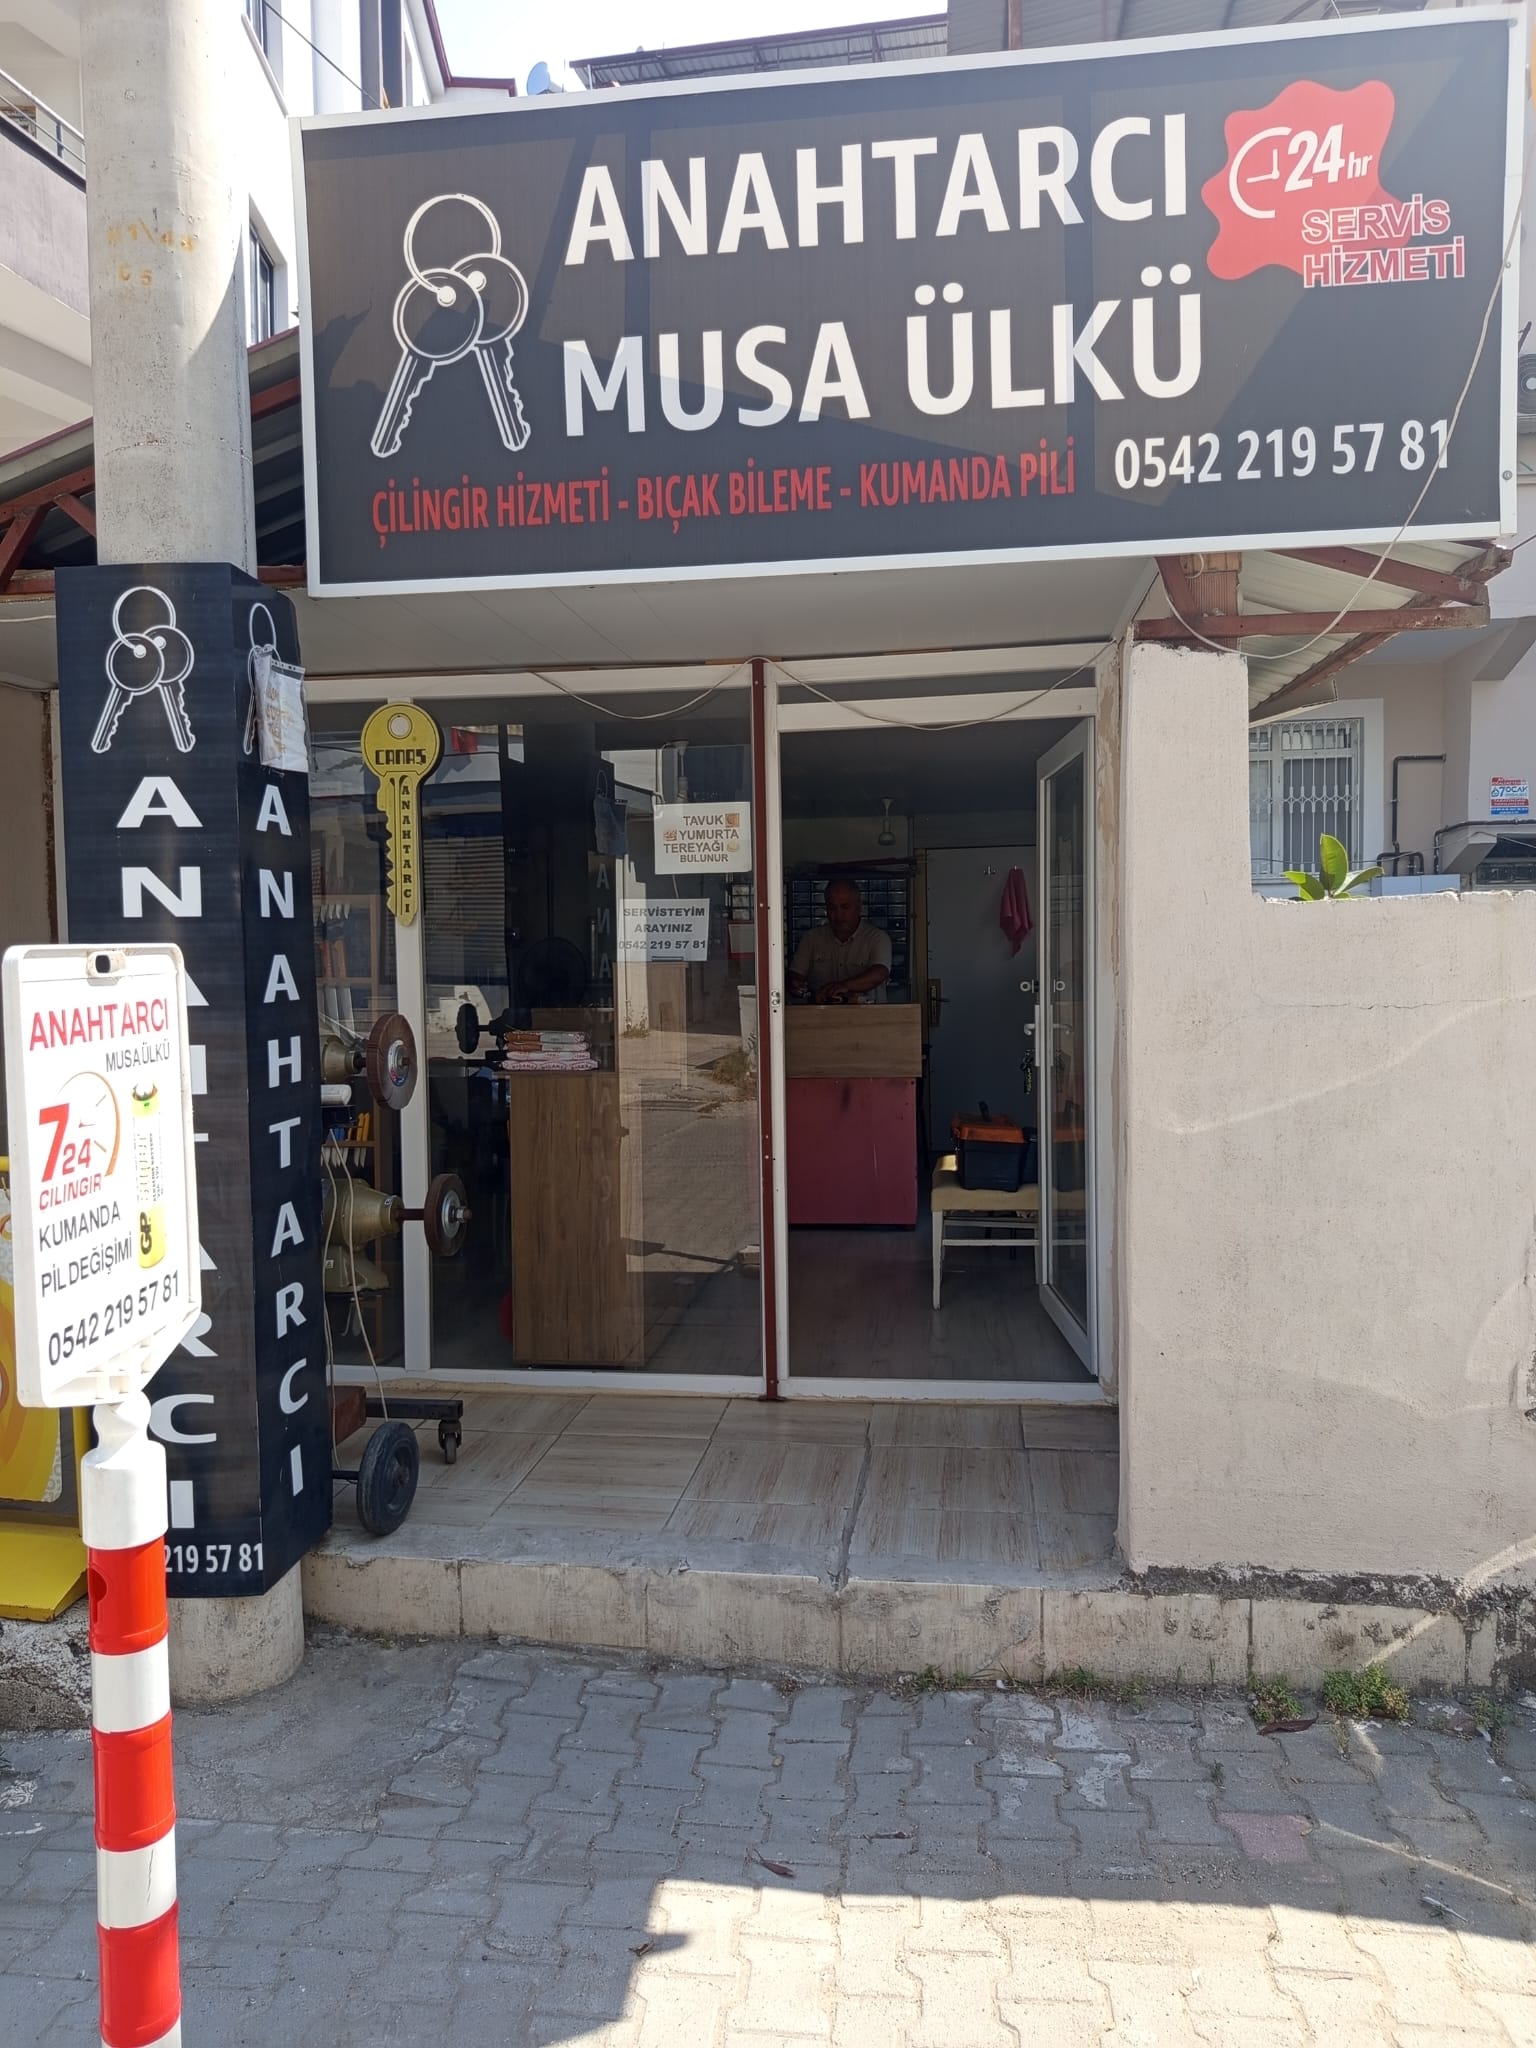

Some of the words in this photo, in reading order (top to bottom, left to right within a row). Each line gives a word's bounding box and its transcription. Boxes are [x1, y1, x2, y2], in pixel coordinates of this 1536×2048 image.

[564, 113, 1188, 267] ANAHTARCI
[1301, 193, 1450, 245] SERVİS
[1303, 235, 1466, 289] HİZMETİ
[563, 321, 871, 438] MUSA
[906, 263, 1202, 415] ÜLKÜ
[1113, 432, 1222, 490] 0542
[1237, 426, 1317, 481] 219
[1331, 422, 1385, 474] 57
[1399, 419, 1449, 472] 81
[372, 474, 489, 549] ÇİLİNGİR
[497, 466, 609, 527] HİZMETİ
[637, 473, 721, 534] BIÇAK
[728, 457, 832, 515] BİLEME
[860, 455, 1011, 508] KUMANDA
[1020, 436, 1075, 497] PİLİ
[679, 830, 739, 841] YUMURTA
[683, 815, 724, 826] TAVUK
[401, 785, 413, 914] ANAHTARCI
[663, 840, 724, 854] TEREYAĞI
[680, 853, 729, 863] BULUNUR
[623, 905, 705, 917] SERVİSTEYİM
[634, 923, 693, 933] ARAYINIZ
[618, 940, 647, 950] 0542
[650, 940, 671, 950] 219
[675, 940, 690, 950] 57
[692, 940, 706, 949] 81
[29, 998, 169, 1052] ANAHTARCI
[62, 1138, 92, 1176] 24
[256, 784, 310, 1497] ANAHTARCI
[39, 1200, 121, 1252] KUMANDA
[49, 1312, 99, 1366] 0542
[104, 1294, 133, 1337] 219
[138, 1280, 158, 1317] 57
[162, 1270, 178, 1303] 81
[206, 1544, 232, 1573] 57
[239, 1542, 264, 1572] 81
